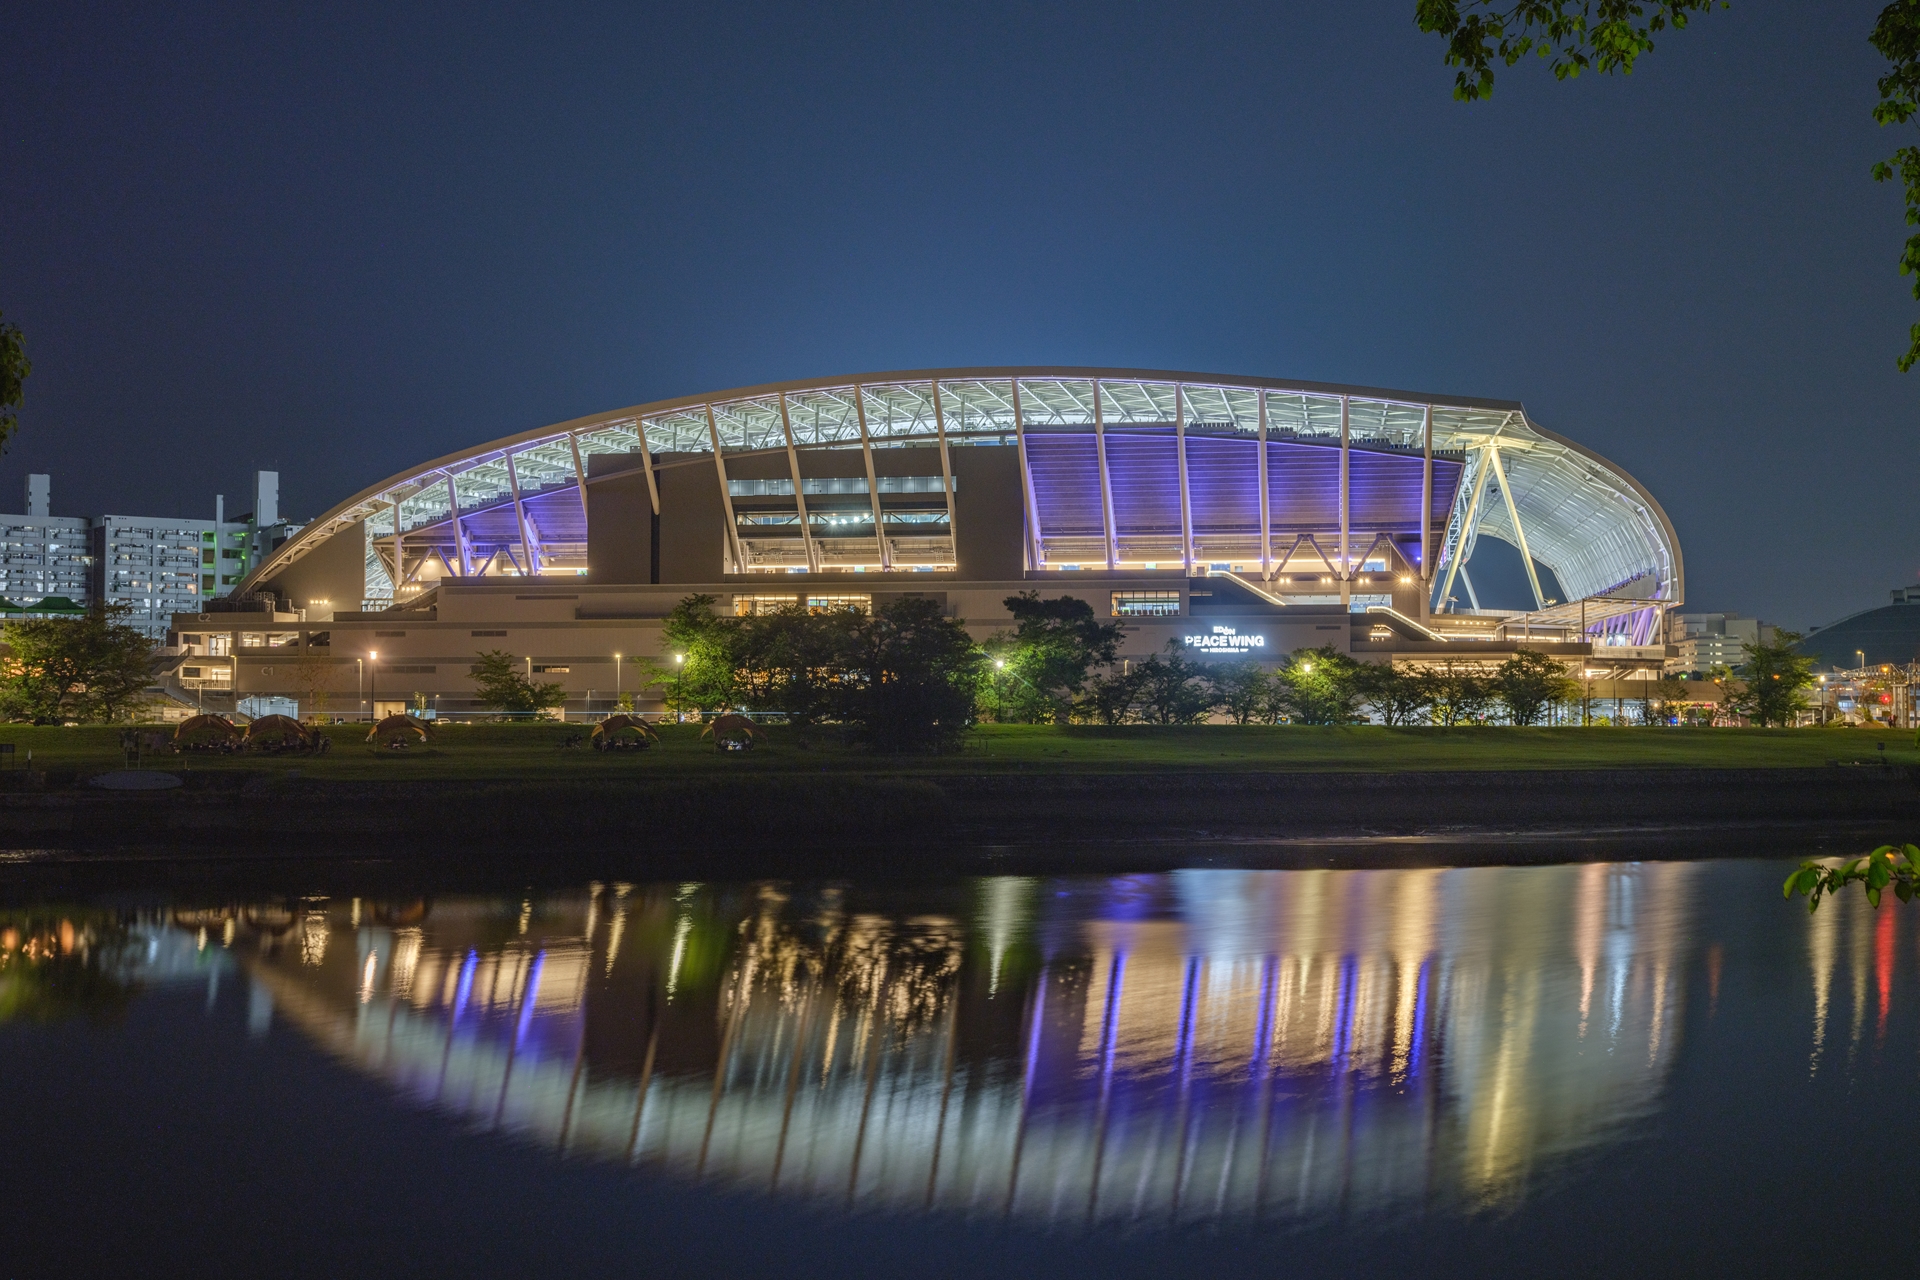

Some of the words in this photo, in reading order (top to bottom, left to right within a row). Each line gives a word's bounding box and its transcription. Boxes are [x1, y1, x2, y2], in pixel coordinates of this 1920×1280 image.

[198, 613, 211, 622] C2
[1185, 635, 1228, 647] PEACE
[1228, 635, 1265, 647] WING
[261, 666, 274, 676] C1
